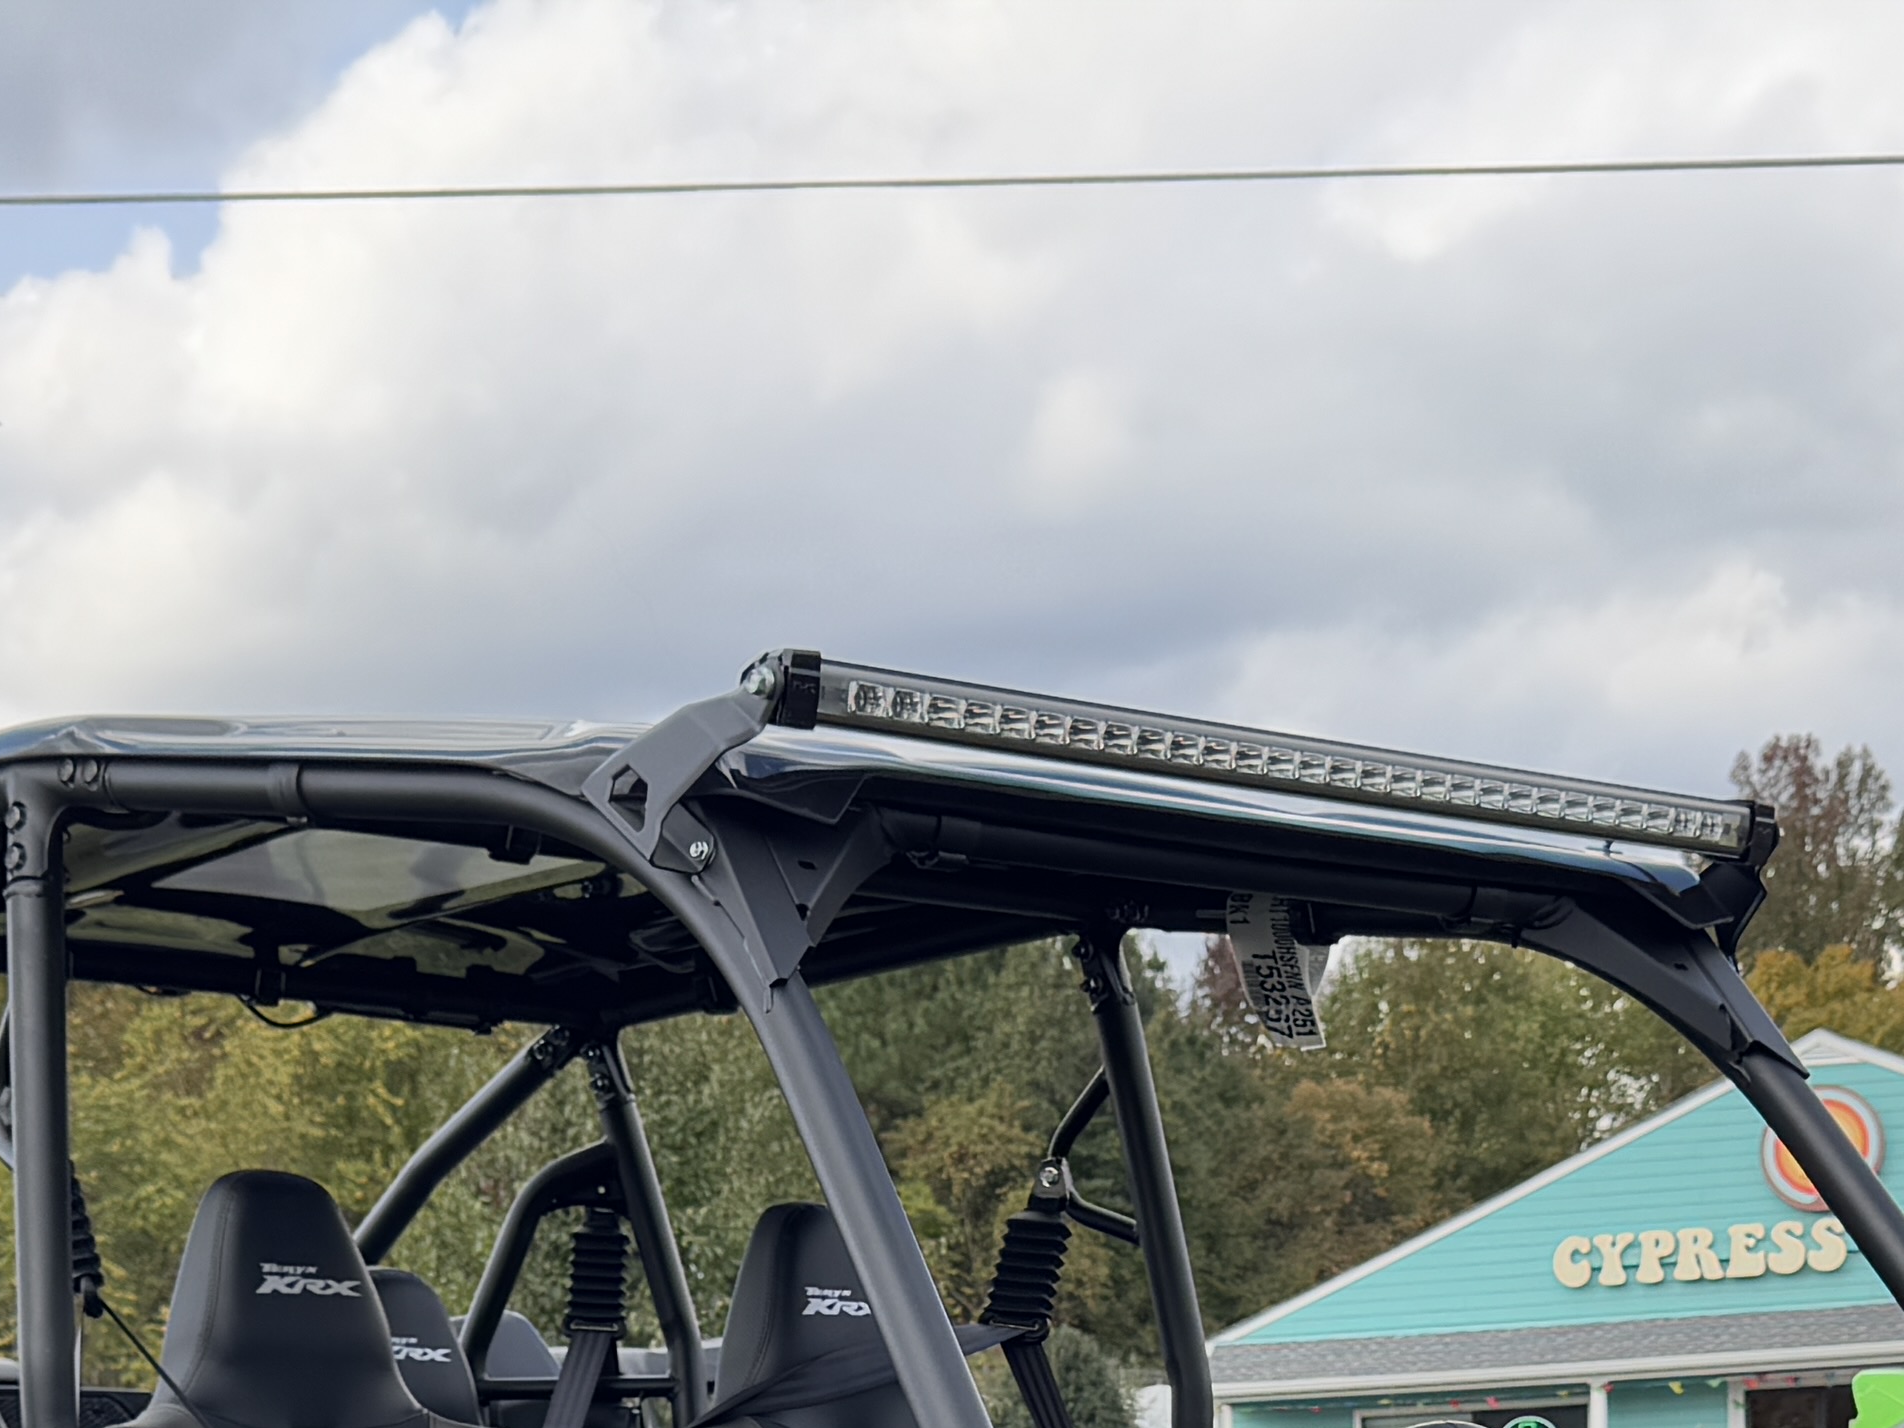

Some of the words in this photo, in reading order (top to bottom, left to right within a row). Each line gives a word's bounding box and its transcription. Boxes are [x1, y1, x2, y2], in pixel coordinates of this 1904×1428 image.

[1552, 1220, 1849, 1288] CYPRESS
[256, 1275, 362, 1297] KRX
[801, 1298, 872, 1316] KR
